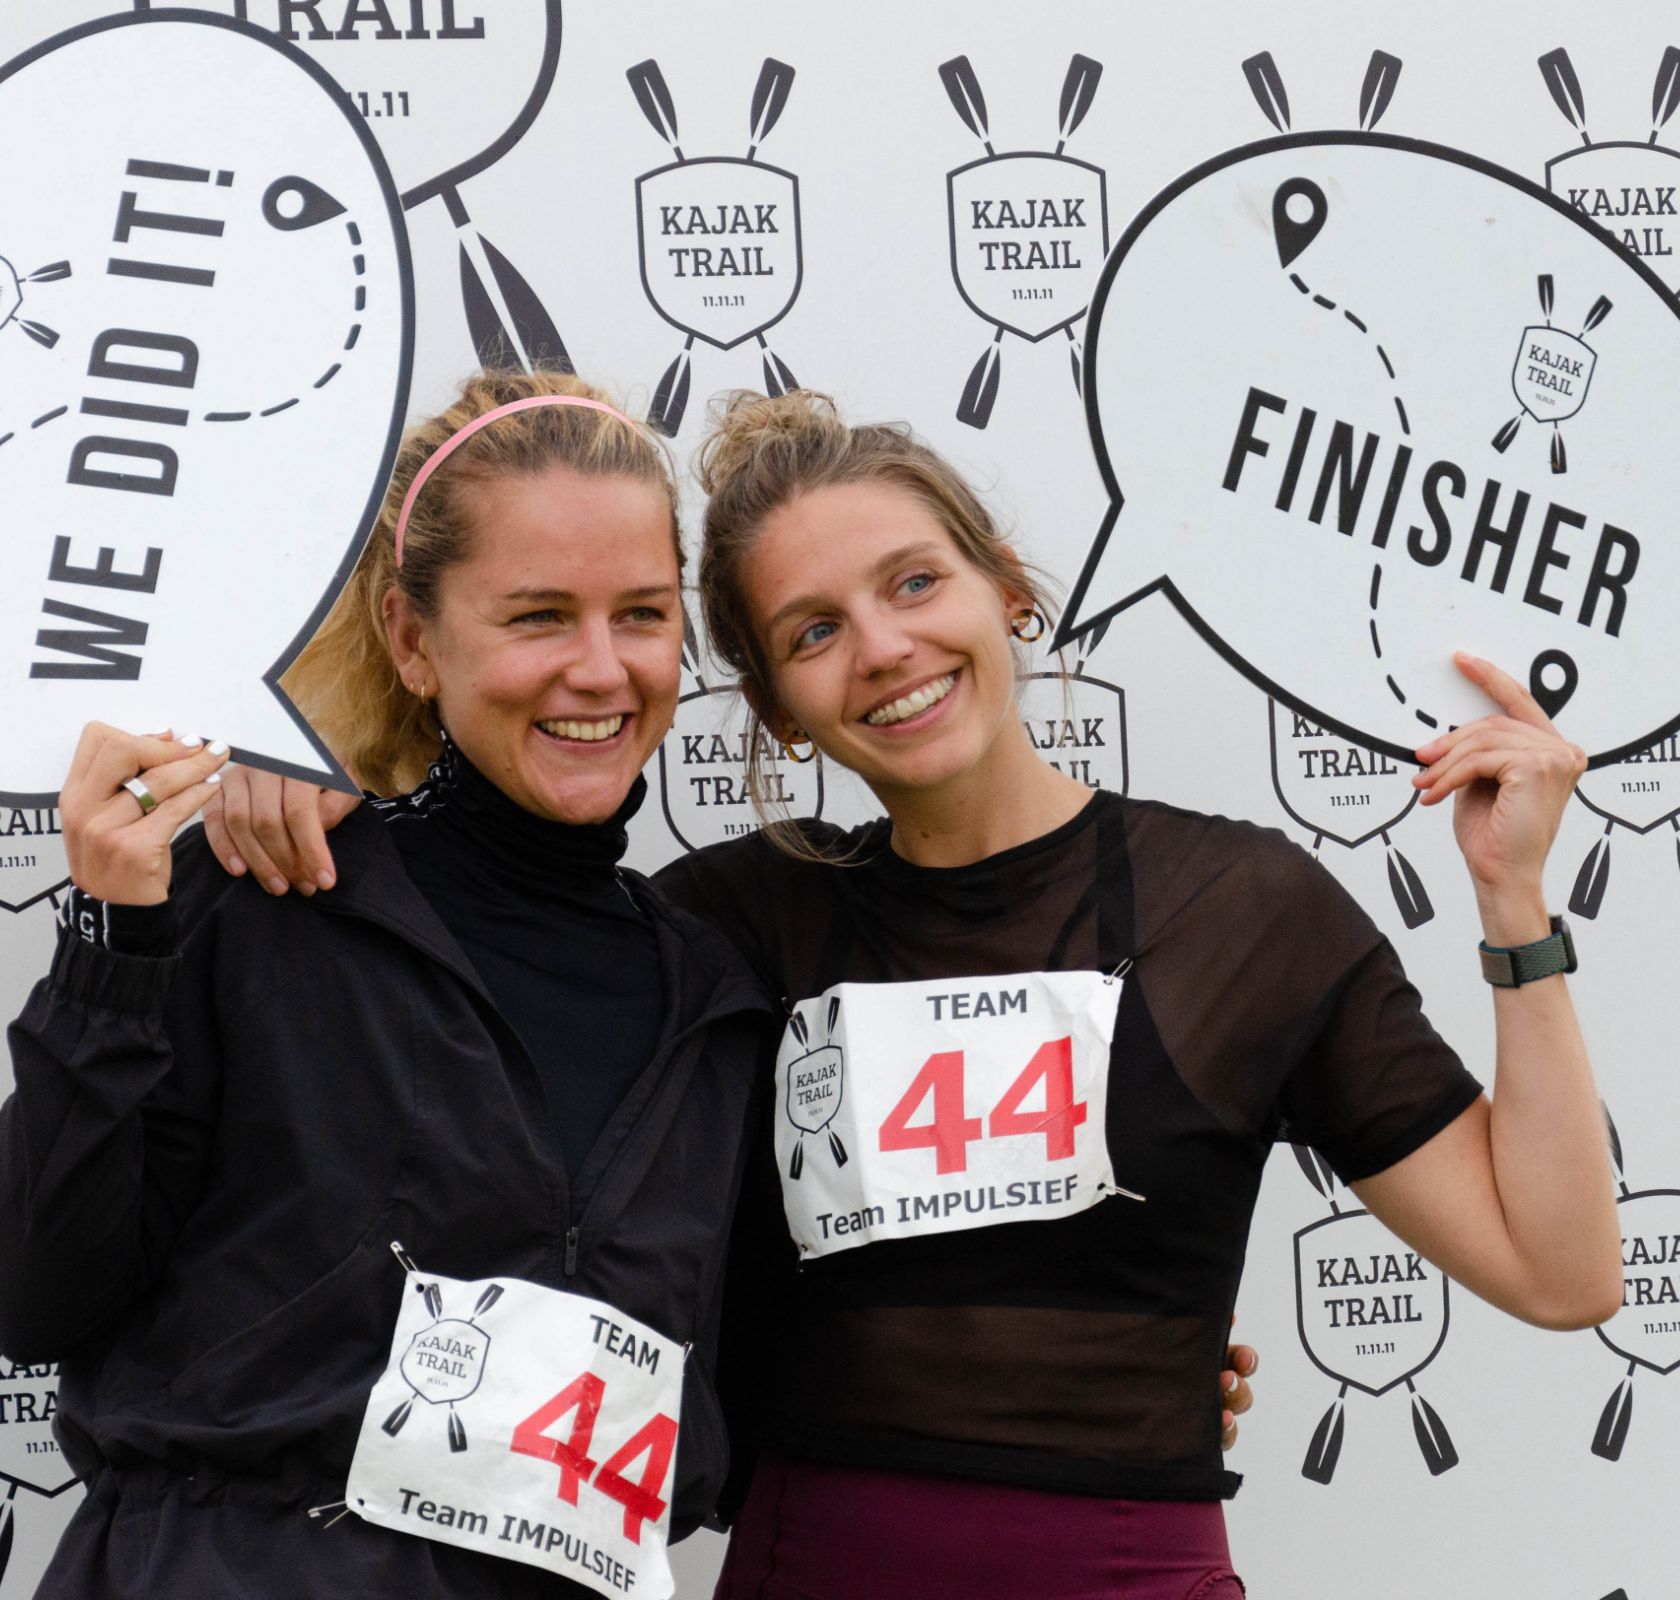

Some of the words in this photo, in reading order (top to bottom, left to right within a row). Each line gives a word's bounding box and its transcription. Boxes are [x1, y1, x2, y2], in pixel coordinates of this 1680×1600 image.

[234, 0, 485, 40] RAIL
[345, 91, 410, 117] 1.11
[971, 198, 1086, 229] KAJAK
[1568, 187, 1678, 217] KAJAK
[106, 158, 235, 287] IT!
[660, 204, 779, 235] KAJAK
[979, 240, 1082, 270] TRAIL
[1604, 227, 1673, 256] AIL
[668, 246, 774, 277] TRAIL
[702, 295, 745, 307] 11.11.11
[1012, 288, 1054, 300] 11.11.11
[1528, 344, 1584, 378] KAJAK
[1527, 365, 1573, 396] TRAIL
[66, 327, 199, 497] DID
[1221, 386, 1641, 638] FINISHER
[29, 534, 164, 681] WE
[1299, 748, 1398, 779] TRAIL
[1330, 794, 1370, 806] 11.11.11
[1621, 781, 1661, 793] 11.11.11
[926, 989, 1028, 1021] TEAM
[795, 1063, 836, 1088] KAJAK
[797, 1084, 833, 1105] TRAIL
[878, 1035, 1088, 1176] 44
[816, 1203, 884, 1240] Team
[897, 1174, 1079, 1223] IMPULSIEF
[1317, 1253, 1428, 1288] KAJAK
[1324, 1294, 1422, 1328] TRAIL
[417, 1336, 476, 1360] KAJAK
[589, 1314, 661, 1376] TEAM
[1355, 1342, 1395, 1355] 11.11.11
[416, 1352, 467, 1379] TRAIL
[510, 1371, 678, 1546] 44
[398, 1487, 489, 1536] Team
[498, 1514, 636, 1593] IMPULSIEF
